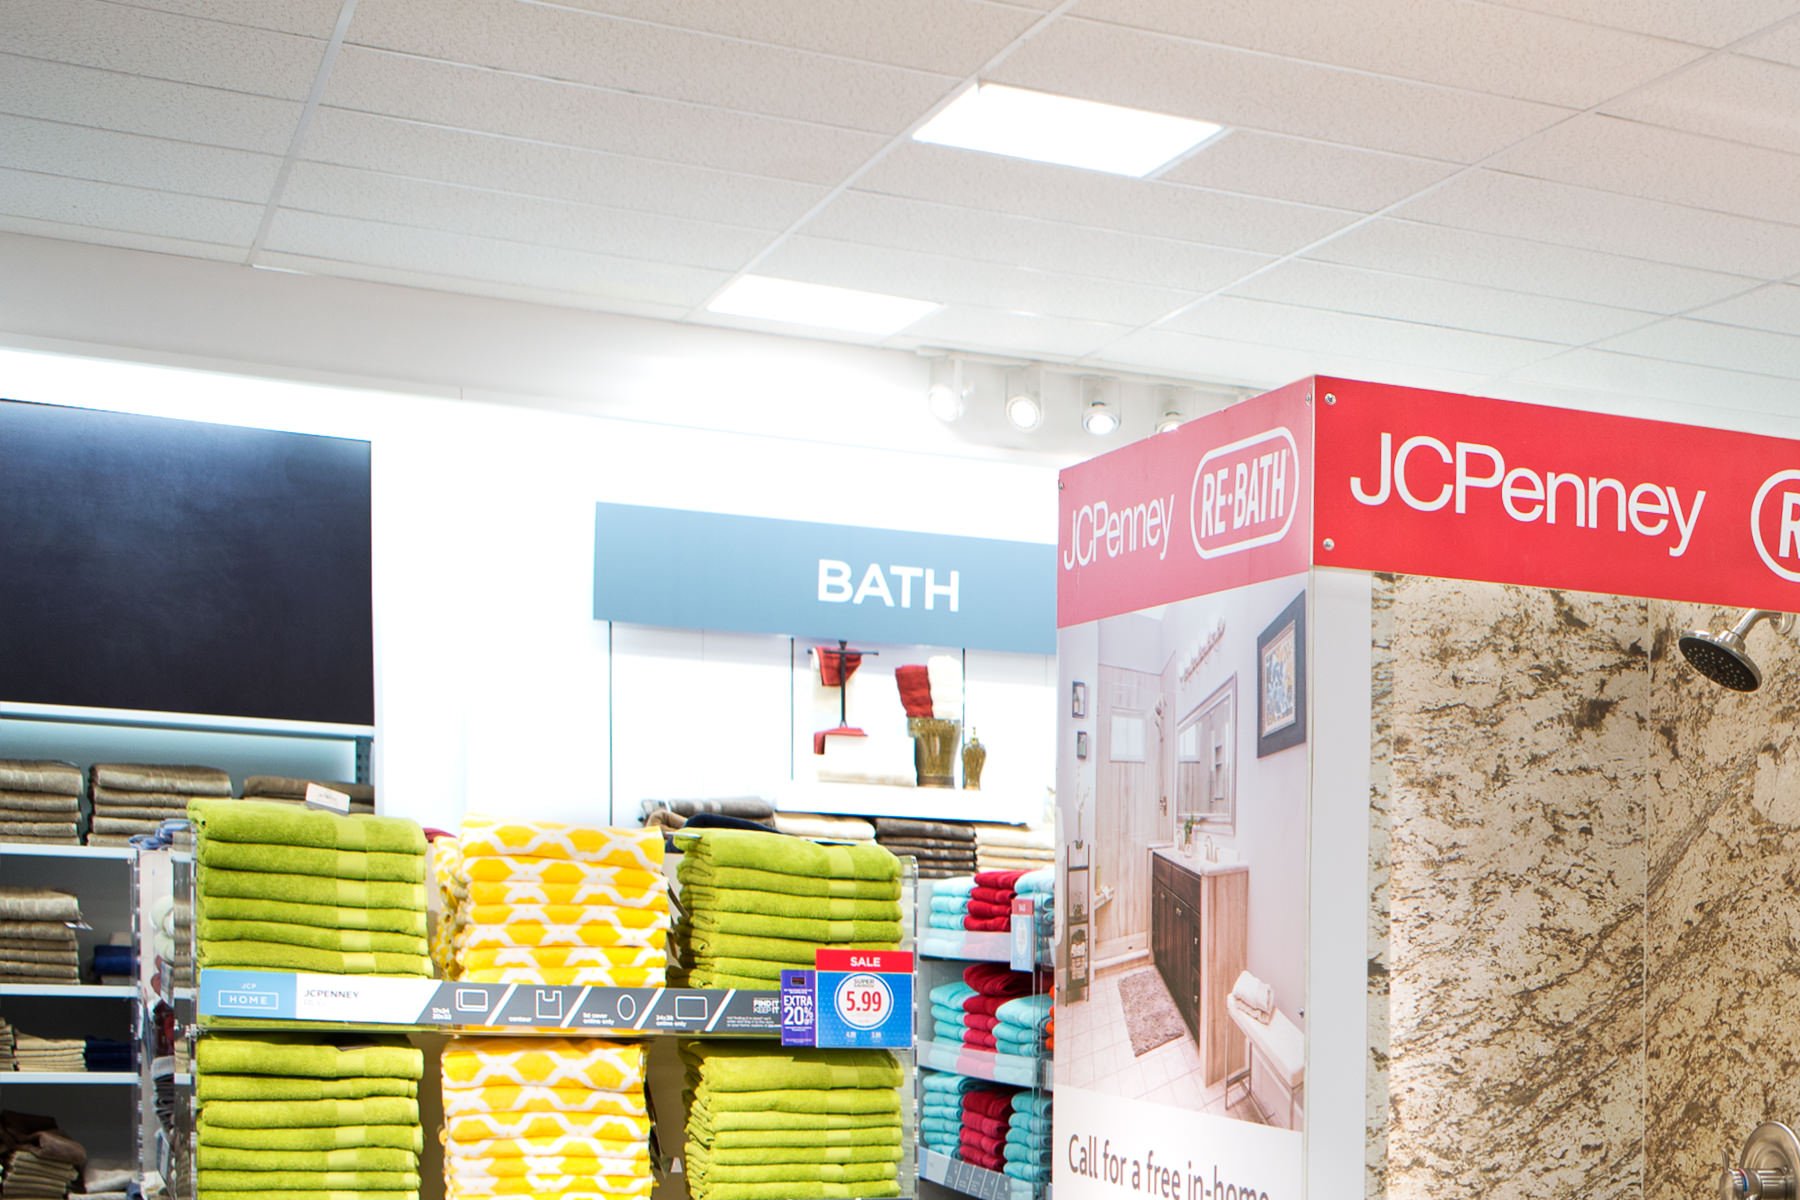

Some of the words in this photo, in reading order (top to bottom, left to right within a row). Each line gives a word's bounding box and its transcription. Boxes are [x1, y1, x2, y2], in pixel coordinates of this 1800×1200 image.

[1349, 431, 1706, 558] JCPenney
[1064, 494, 1174, 570] JCPenney
[818, 559, 959, 612] BATH
[850, 957, 881, 967] SALE
[229, 995, 268, 1005] HOME
[304, 990, 359, 999] JCPENNEY
[784, 995, 813, 1007] EXTRA
[846, 991, 882, 1012] 5.99
[784, 1007, 813, 1025] 20%
[1068, 1134, 1098, 1180] Call
[1103, 1140, 1127, 1186] for
[1132, 1159, 1141, 1190] a
